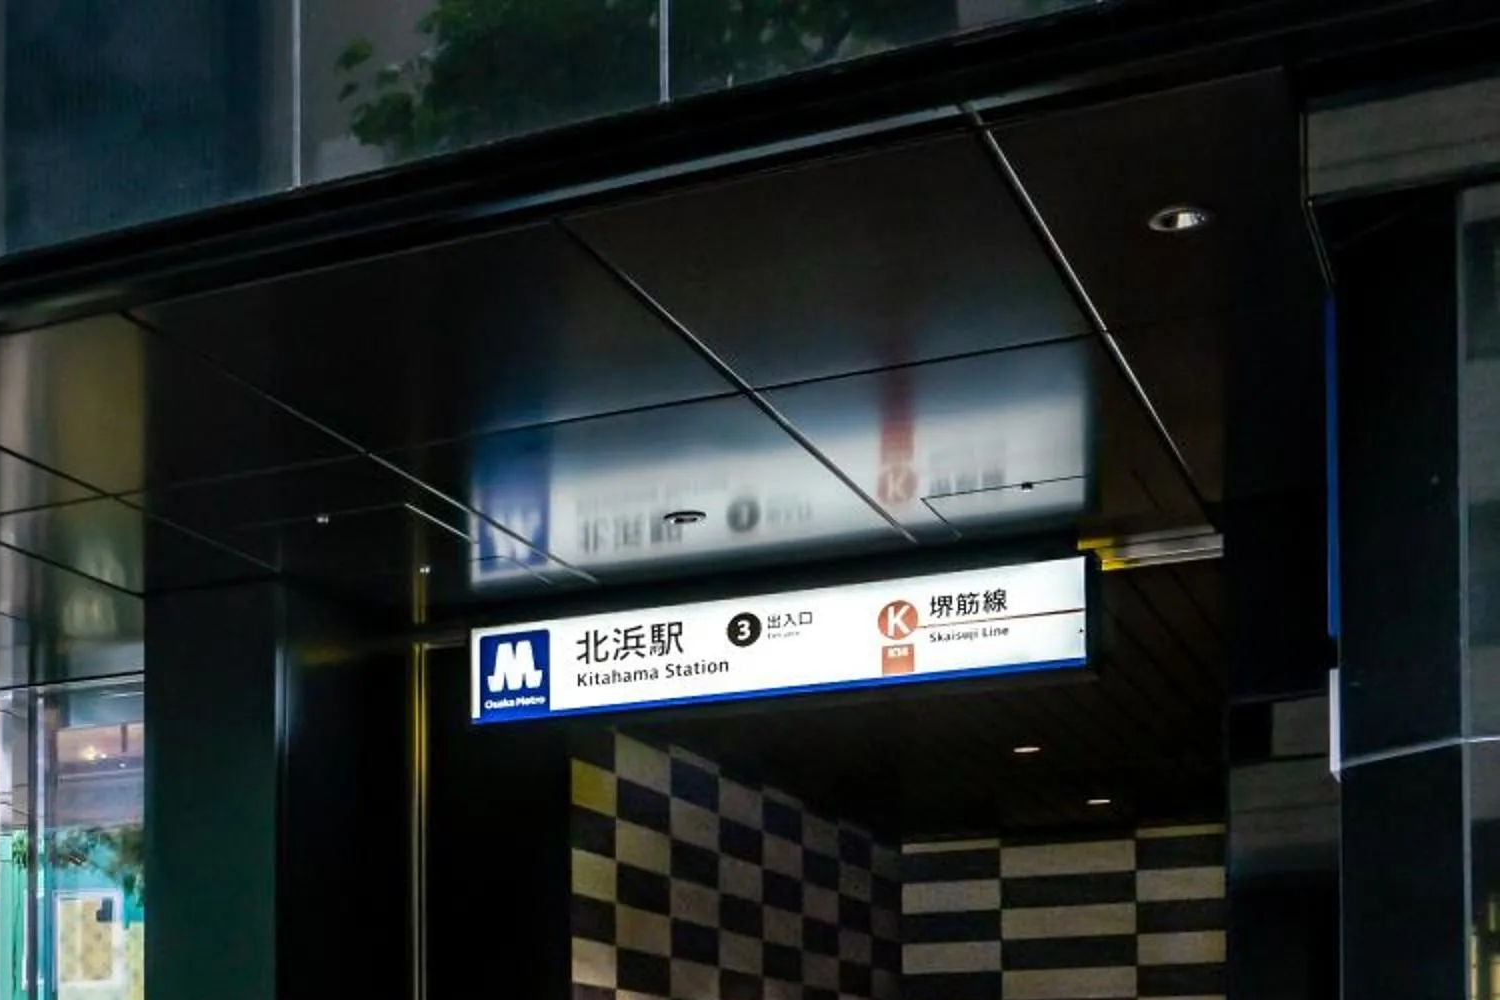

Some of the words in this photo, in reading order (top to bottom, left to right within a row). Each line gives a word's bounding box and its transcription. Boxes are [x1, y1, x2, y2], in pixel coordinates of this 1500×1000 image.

[930, 588, 1008, 618] 堺筋線
[766, 611, 813, 629] 出入口
[885, 602, 913, 638] K
[982, 625, 1010, 638] Line
[575, 621, 684, 665] 北浜駅
[576, 668, 659, 688] Kitahama
[665, 659, 730, 679] Station
